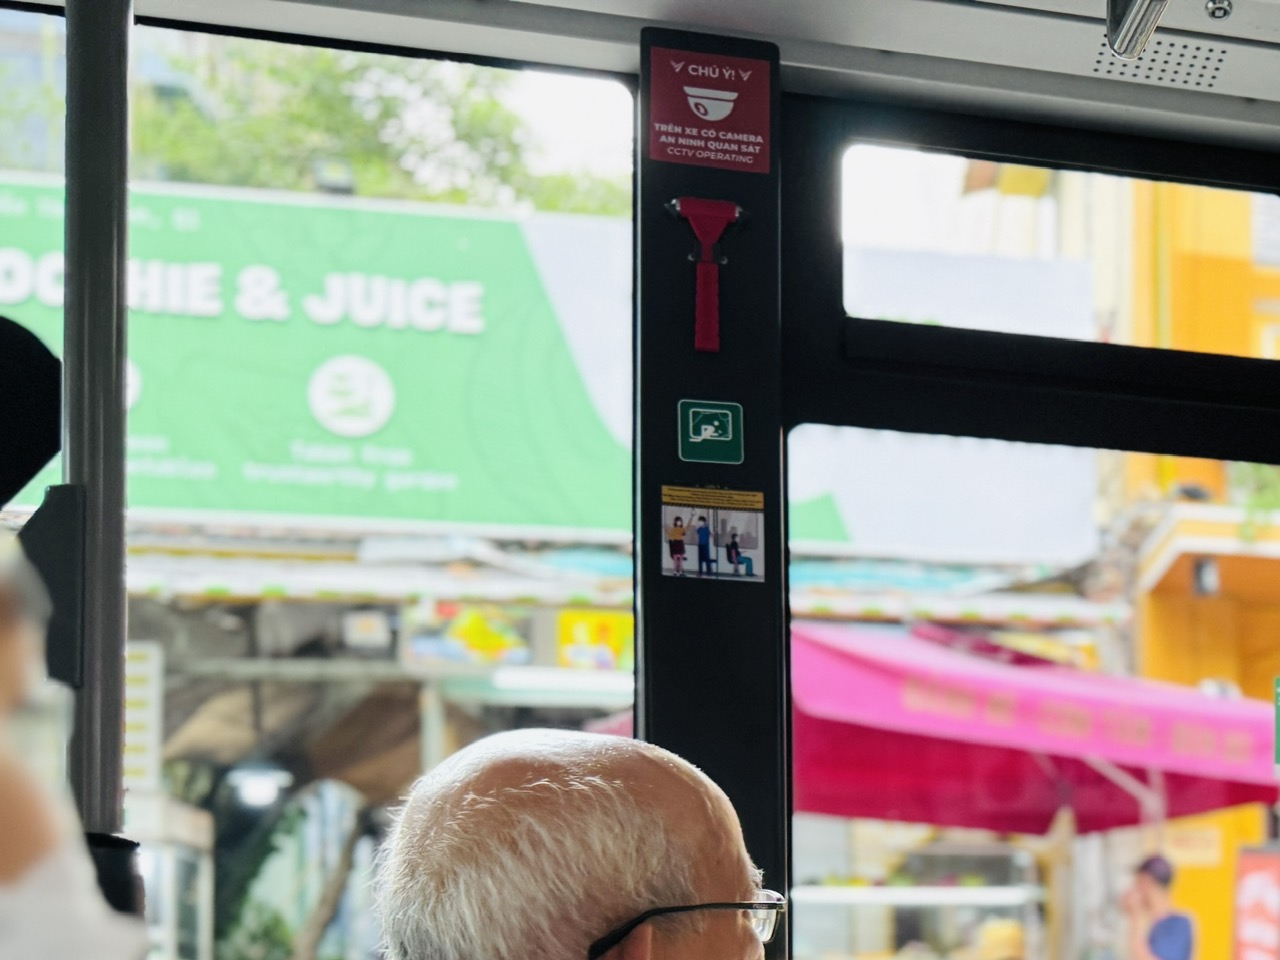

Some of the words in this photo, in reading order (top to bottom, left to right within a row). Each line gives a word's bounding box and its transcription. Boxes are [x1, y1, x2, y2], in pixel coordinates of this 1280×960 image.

[654, 122, 682, 134] TRÊN
[685, 126, 698, 136] XE
[701, 127, 717, 138] CÓ
[718, 131, 764, 143] CAMERA
[659, 134, 676, 144] AN
[678, 137, 705, 148] NINH
[707, 140, 738, 151] QUAN
[667, 146, 695, 157] CCTV
[696, 150, 754, 163] OPERATING
[0, 246, 223, 317] OOHIE
[234, 262, 291, 321] &
[301, 271, 486, 335] JUICE
